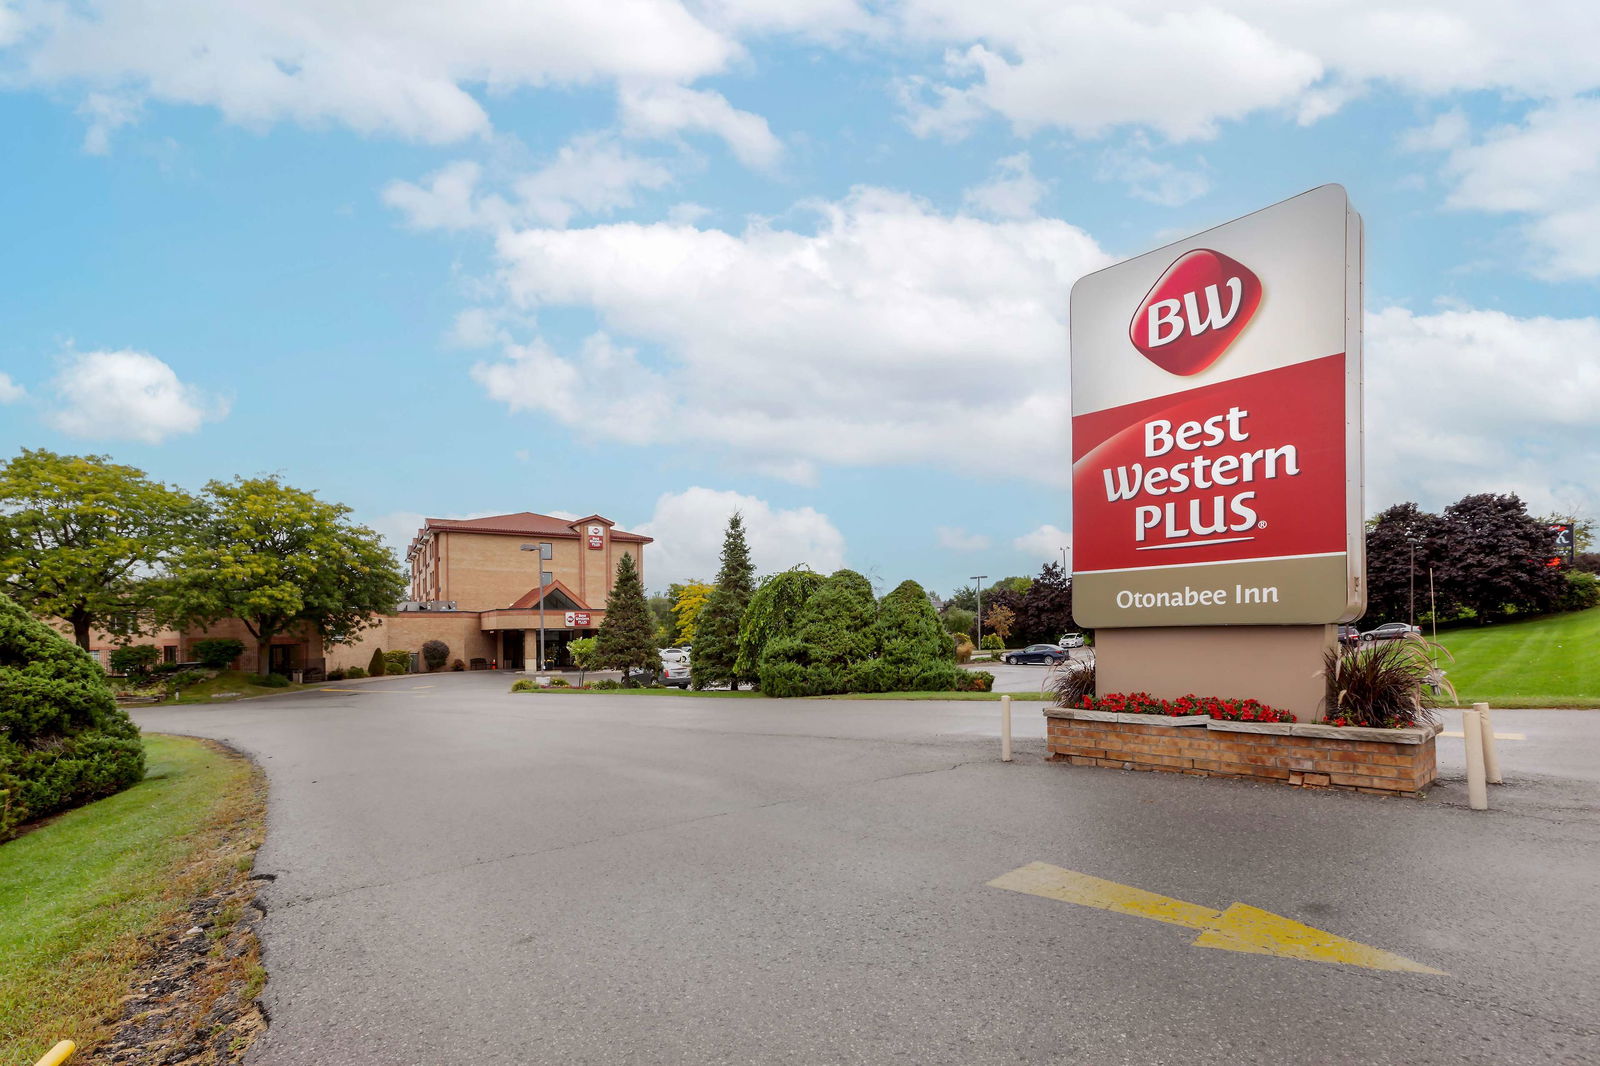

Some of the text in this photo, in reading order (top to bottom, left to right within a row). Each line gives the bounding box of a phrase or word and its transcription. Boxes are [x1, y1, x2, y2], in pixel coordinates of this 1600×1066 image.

[1148, 276, 1242, 348] BW
[1145, 407, 1249, 457] Best
[1103, 444, 1300, 502] Western
[1116, 584, 1279, 608] Otonabee Inn
